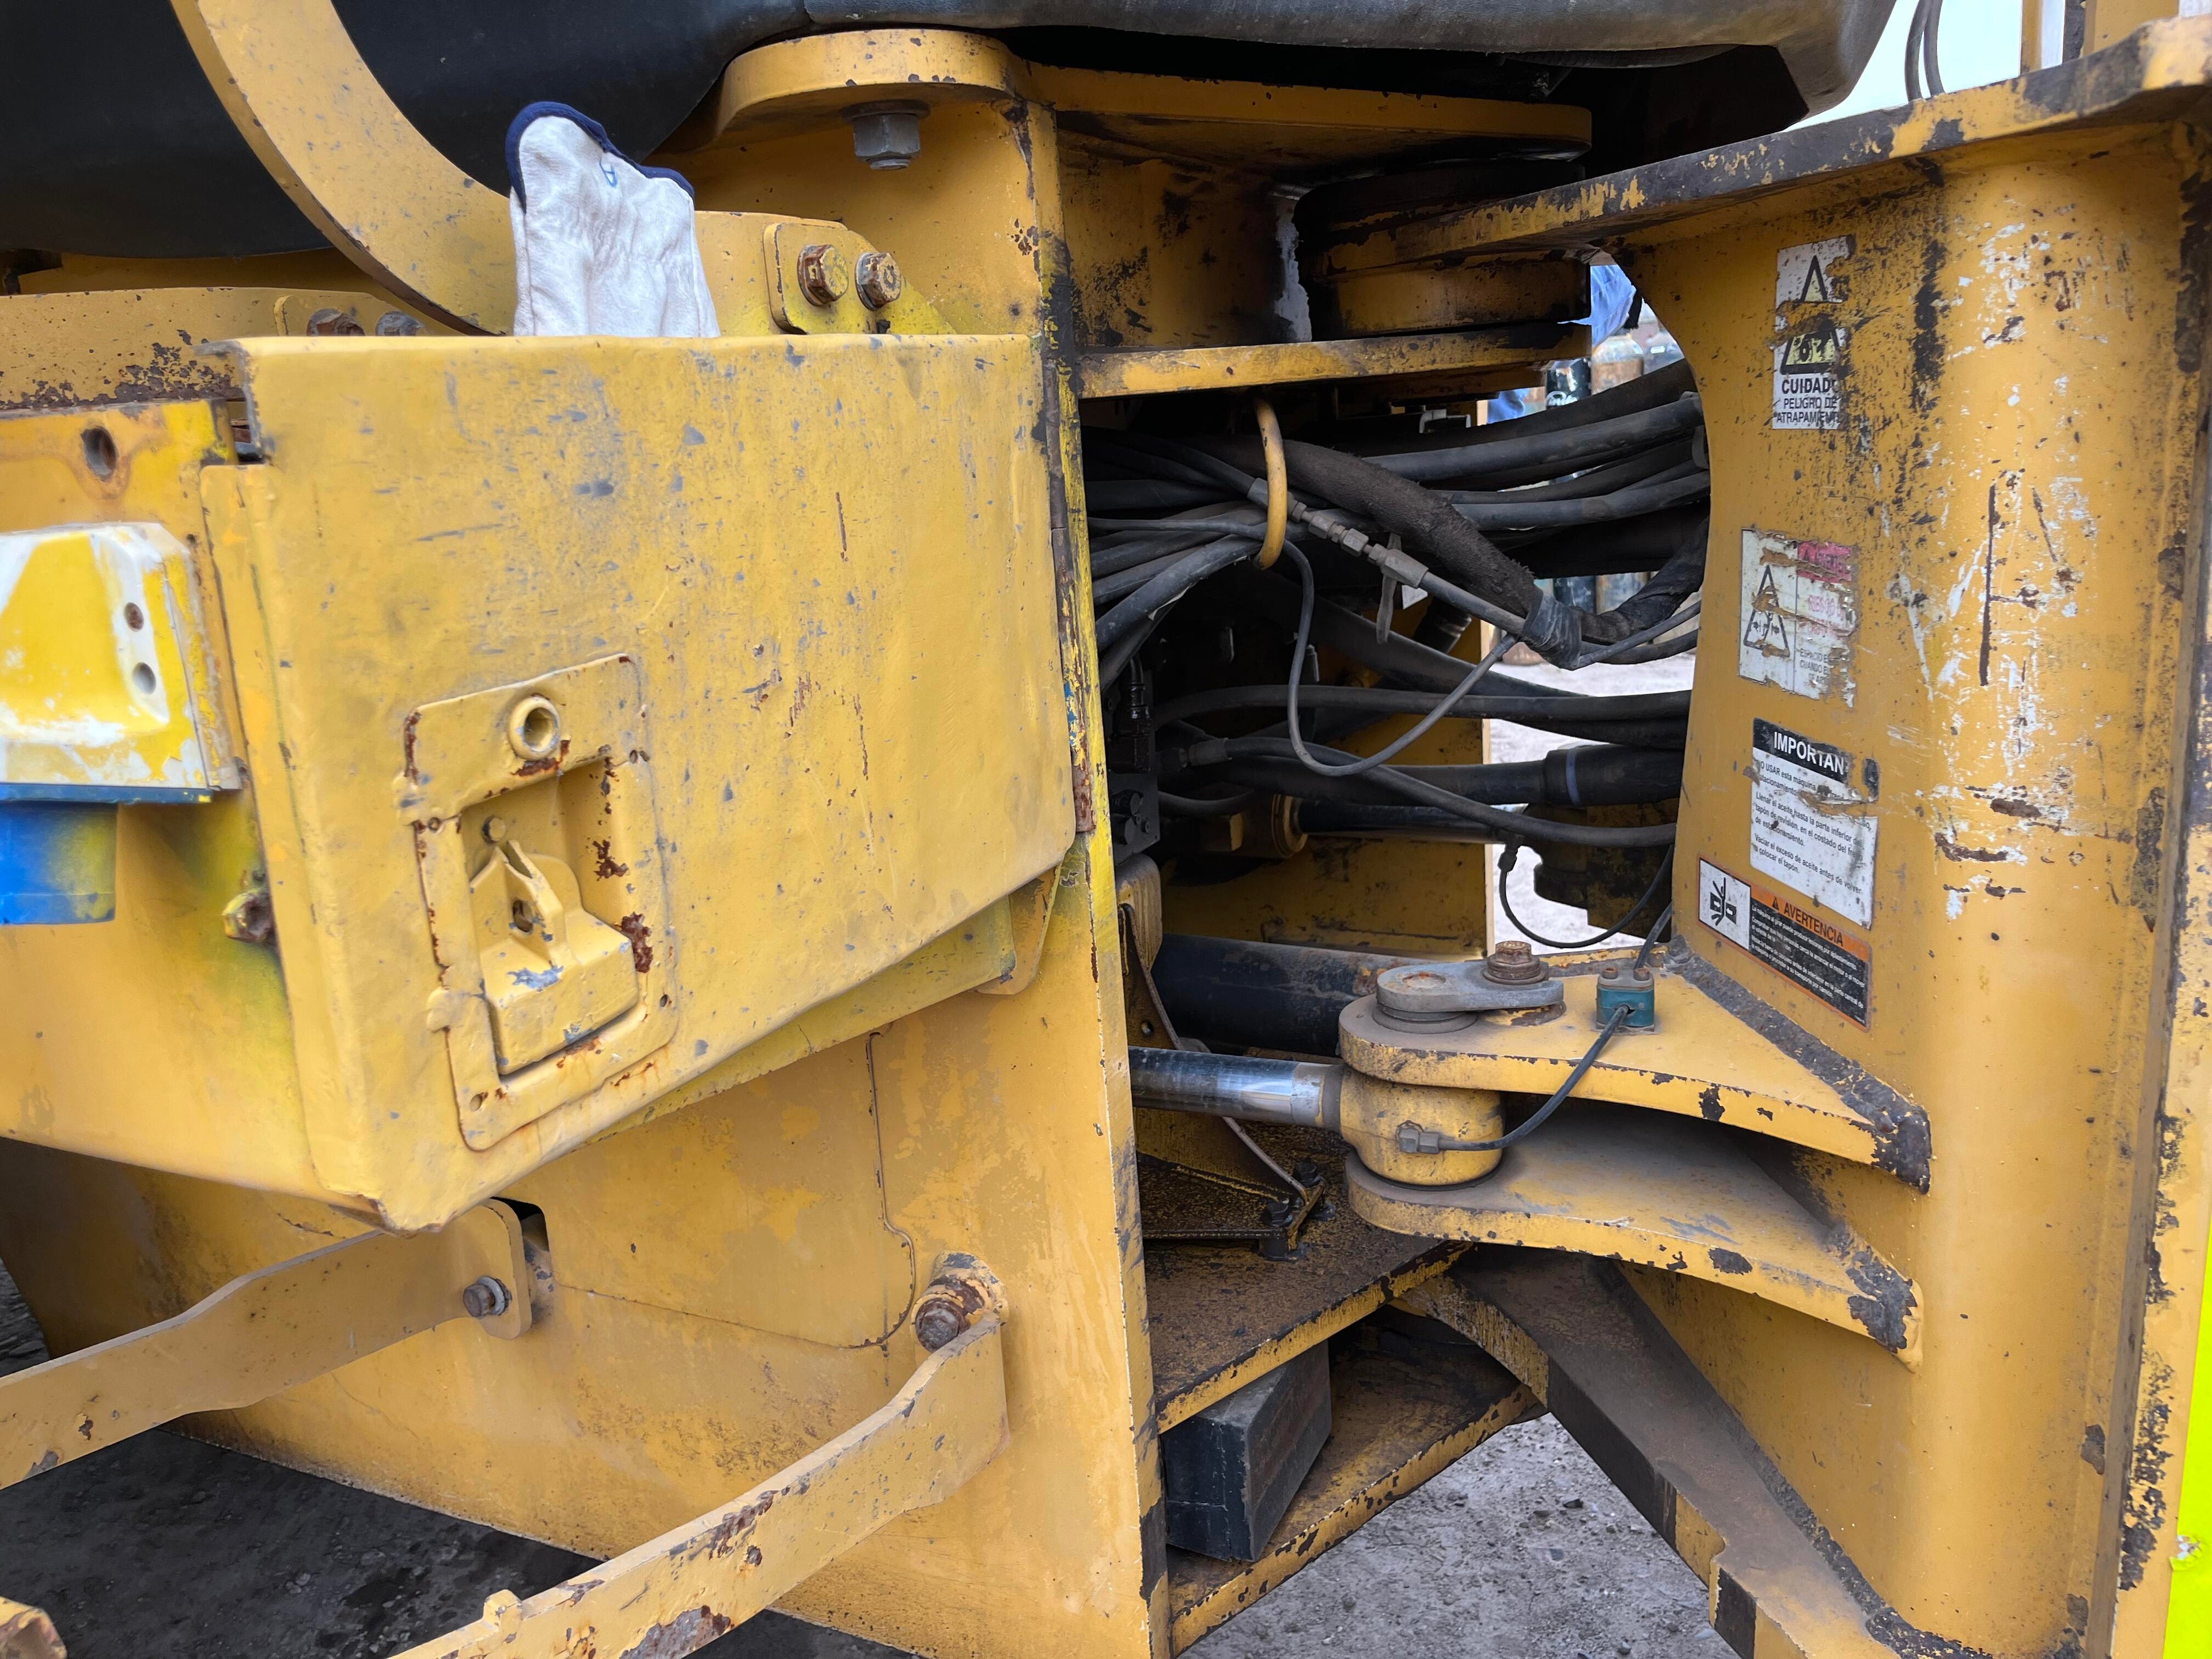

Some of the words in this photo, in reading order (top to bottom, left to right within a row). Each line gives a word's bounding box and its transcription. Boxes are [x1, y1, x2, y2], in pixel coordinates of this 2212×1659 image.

[1783, 397, 1822, 409] PELIGRO
[1824, 396, 1838, 408] DE
[1777, 411, 1839, 424] ATRAPAMIENT
[1759, 774, 1798, 796] stacionamiento
[1766, 763, 1781, 776] USAR
[1781, 771, 1792, 781] esta
[1756, 791, 1771, 805] Llenar
[1772, 800, 1777, 808] el
[1794, 808, 1808, 823] hasta
[1809, 816, 1815, 825] la
[1816, 820, 1830, 832] parte
[1755, 816, 1762, 825] de
[1763, 820, 1805, 847] estonamiento.
[1770, 811, 1777, 820] de
[1800, 826, 1807, 835] en
[1808, 830, 1813, 838] el
[1814, 833, 1836, 849] costado
[1838, 843, 1846, 853] del
[1755, 833, 1770, 847] Vaciar
[1776, 846, 1794, 860] exceso
[1794, 854, 1801, 864] de
[1819, 868, 1835, 881] antes
[1835, 876, 1843, 885] de
[1759, 847, 1777, 862] colocar
[1783, 902, 1844, 948] AVERTENCIA
